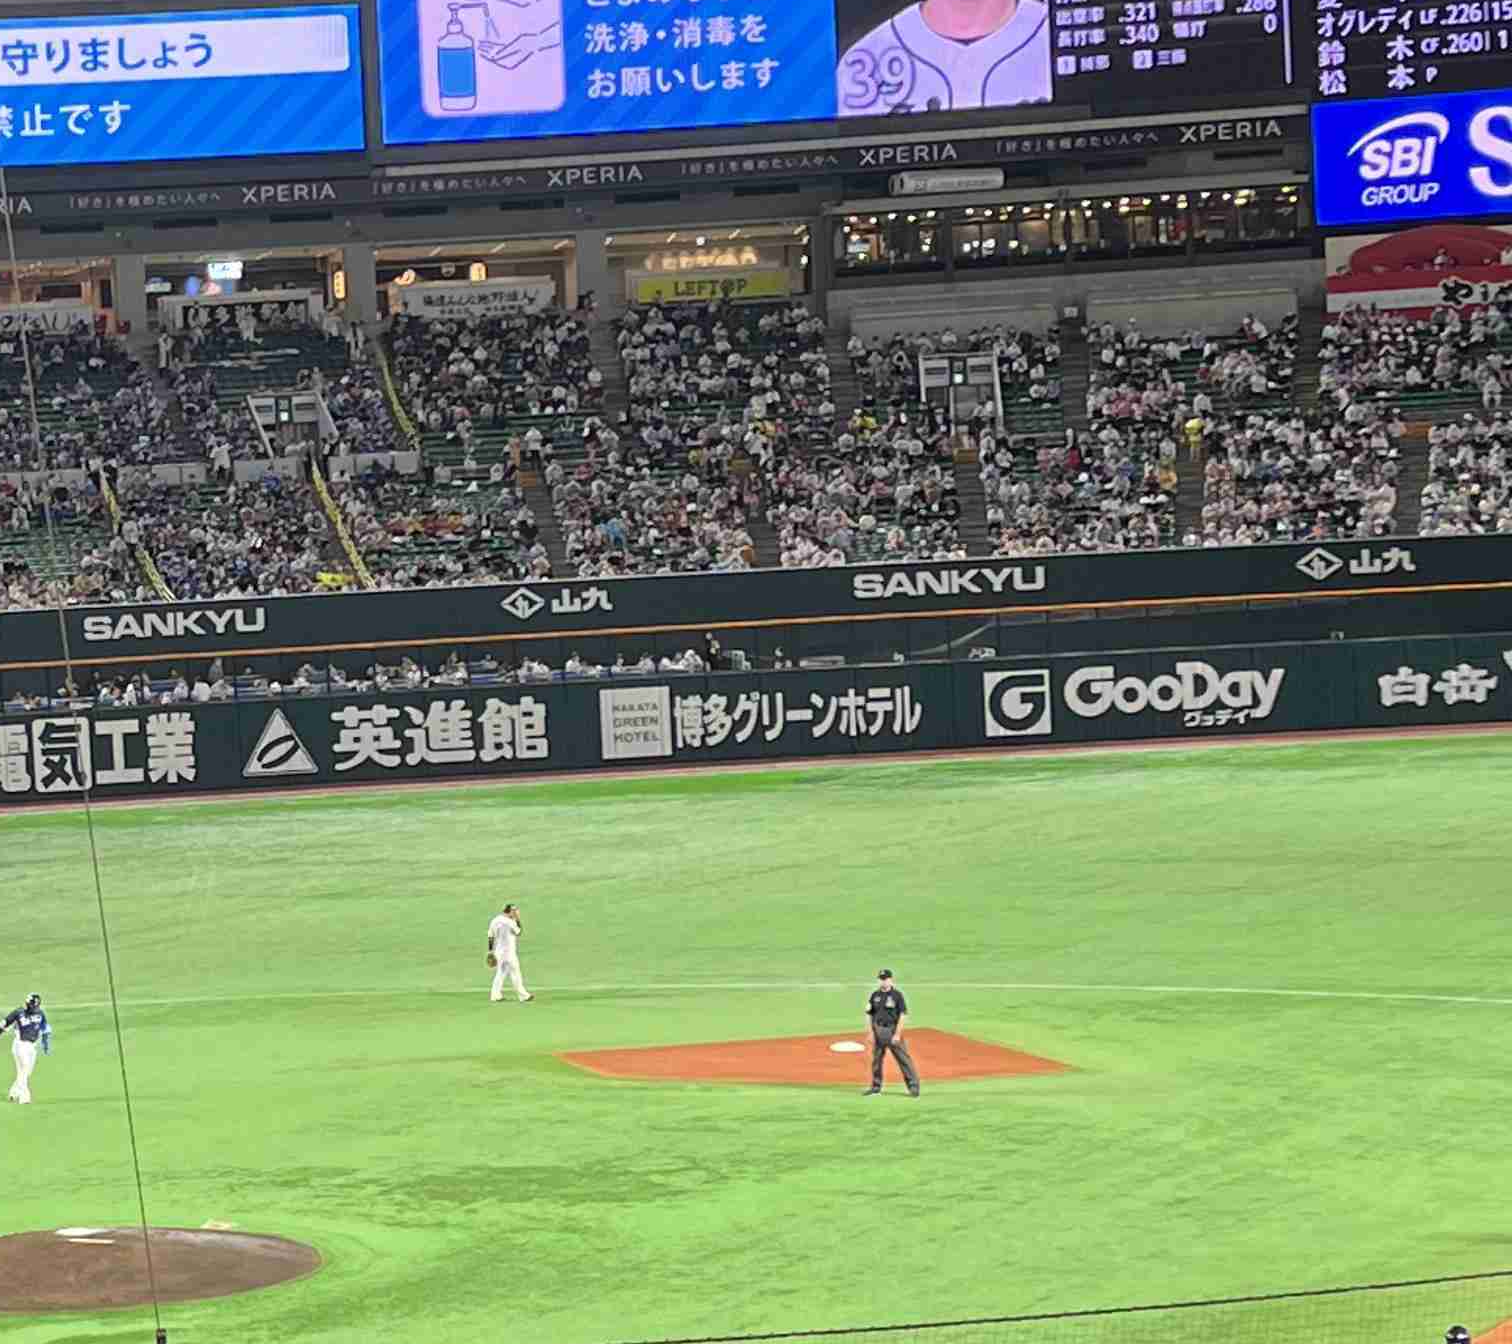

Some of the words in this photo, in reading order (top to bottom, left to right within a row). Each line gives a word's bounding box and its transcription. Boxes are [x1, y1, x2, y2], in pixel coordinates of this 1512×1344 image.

[1117, 2, 1157, 23] .321
[1317, 7, 1414, 37] オグレディ
[1440, 2, 1482, 25] .226
[1491, 0, 1512, 20] 15
[584, 13, 767, 55] 洗浄・消毒を
[1118, 23, 1160, 45] .340
[1262, 14, 1277, 33] 0
[1441, 30, 1484, 55] .260
[1497, 29, 1508, 49] 1
[588, 59, 780, 99] お願いします
[843, 45, 916, 109] 39
[1178, 119, 1283, 144] XPERIA
[859, 142, 958, 167] XPERIA
[1358, 135, 1437, 181] SBI
[547, 165, 644, 188] XPERIA
[242, 183, 337, 205] XPERIA
[1361, 181, 1440, 206] GROUP
[1349, 547, 1417, 575] 山九
[853, 566, 1046, 600] SANKYU
[550, 586, 614, 614] 山九
[83, 607, 266, 642] SANKYU
[1063, 660, 1285, 719] GooDay
[1377, 662, 1499, 708] 白岳
[612, 716, 659, 729] GREEN
[675, 685, 923, 750] 博多グリーンホテル
[1183, 708, 1252, 729] グッデイ
[330, 694, 550, 773] 英進館
[613, 731, 661, 744] HOTEL
